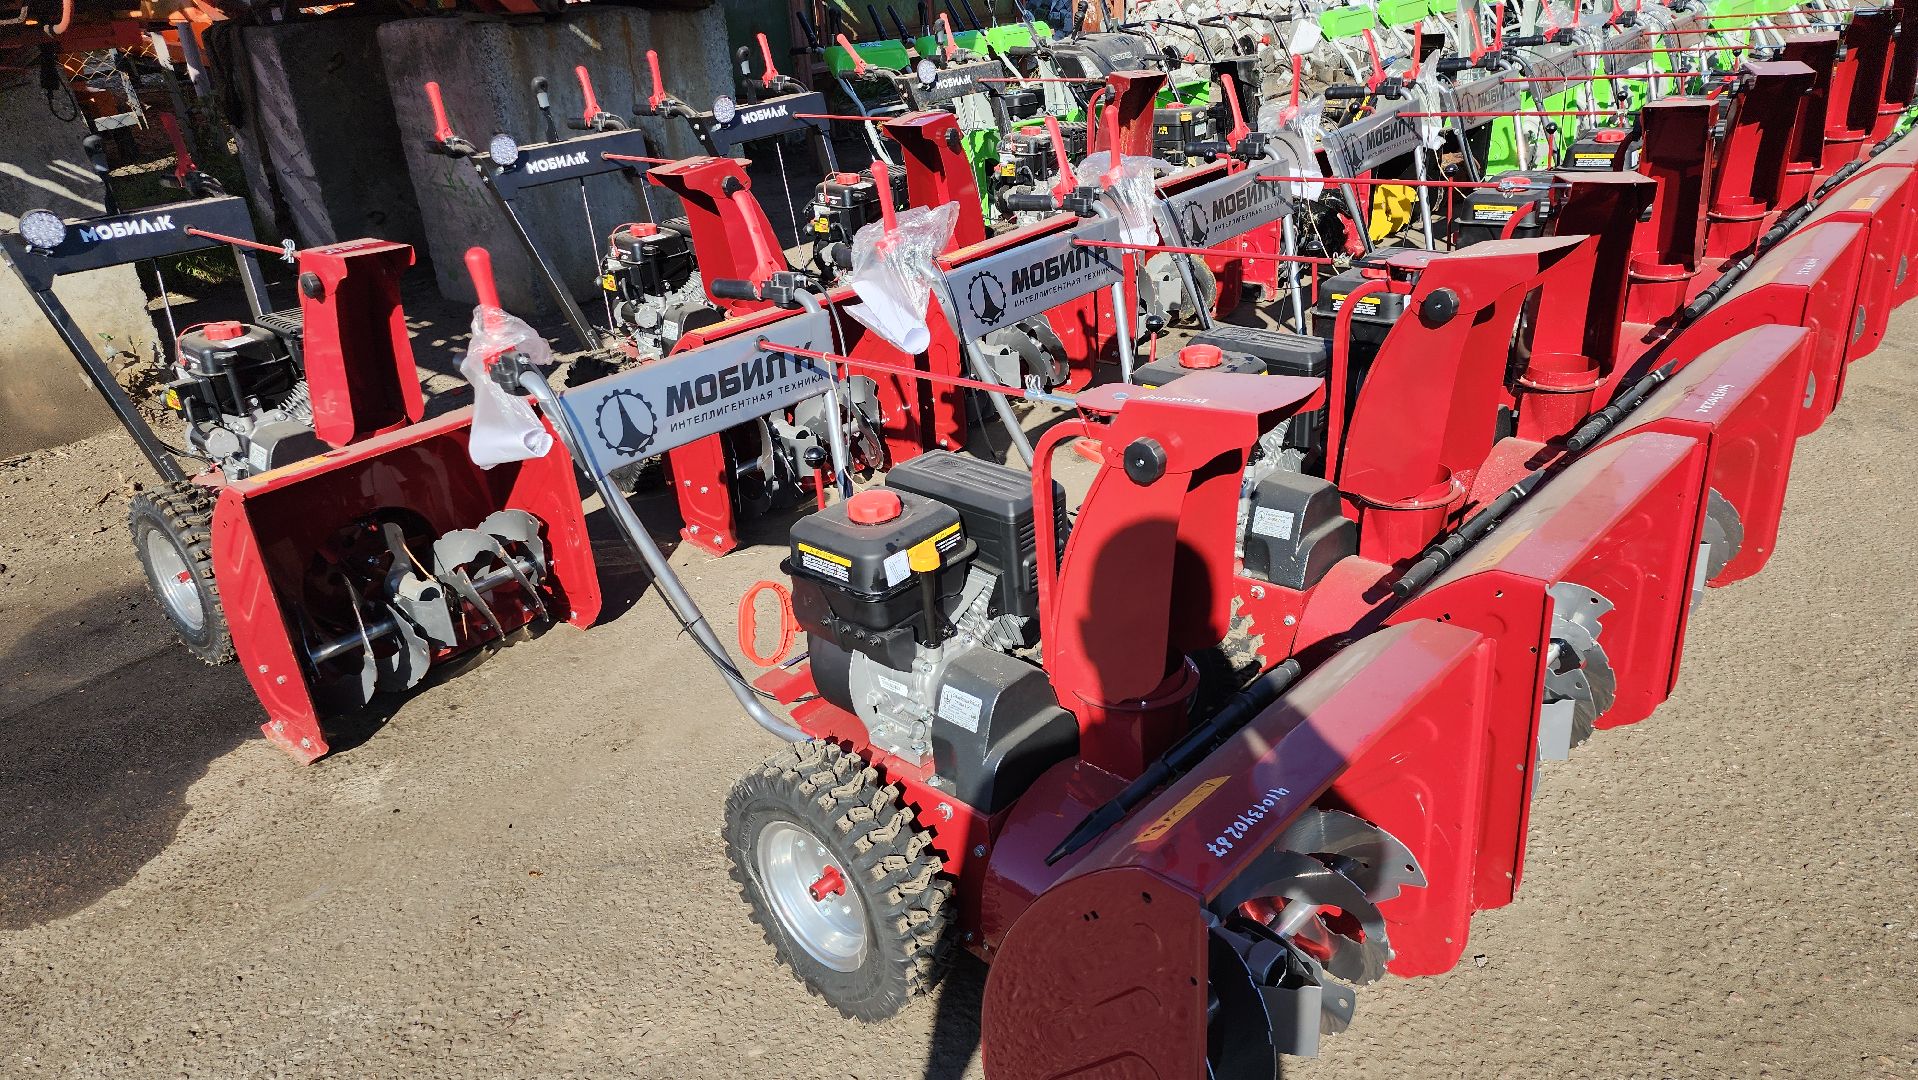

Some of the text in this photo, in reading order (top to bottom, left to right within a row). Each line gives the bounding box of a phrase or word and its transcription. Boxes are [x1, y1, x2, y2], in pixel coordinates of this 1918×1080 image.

[1011, 245, 1089, 295] МОБИЛ
[1014, 278, 1081, 307] ИНТЕЛЛИГЕНТНАЯ
[666, 351, 786, 417] МОБИЛ
[670, 373, 824, 433] ИНТЕЛЛИГЕНТНАЯ ТЕХНИКА
